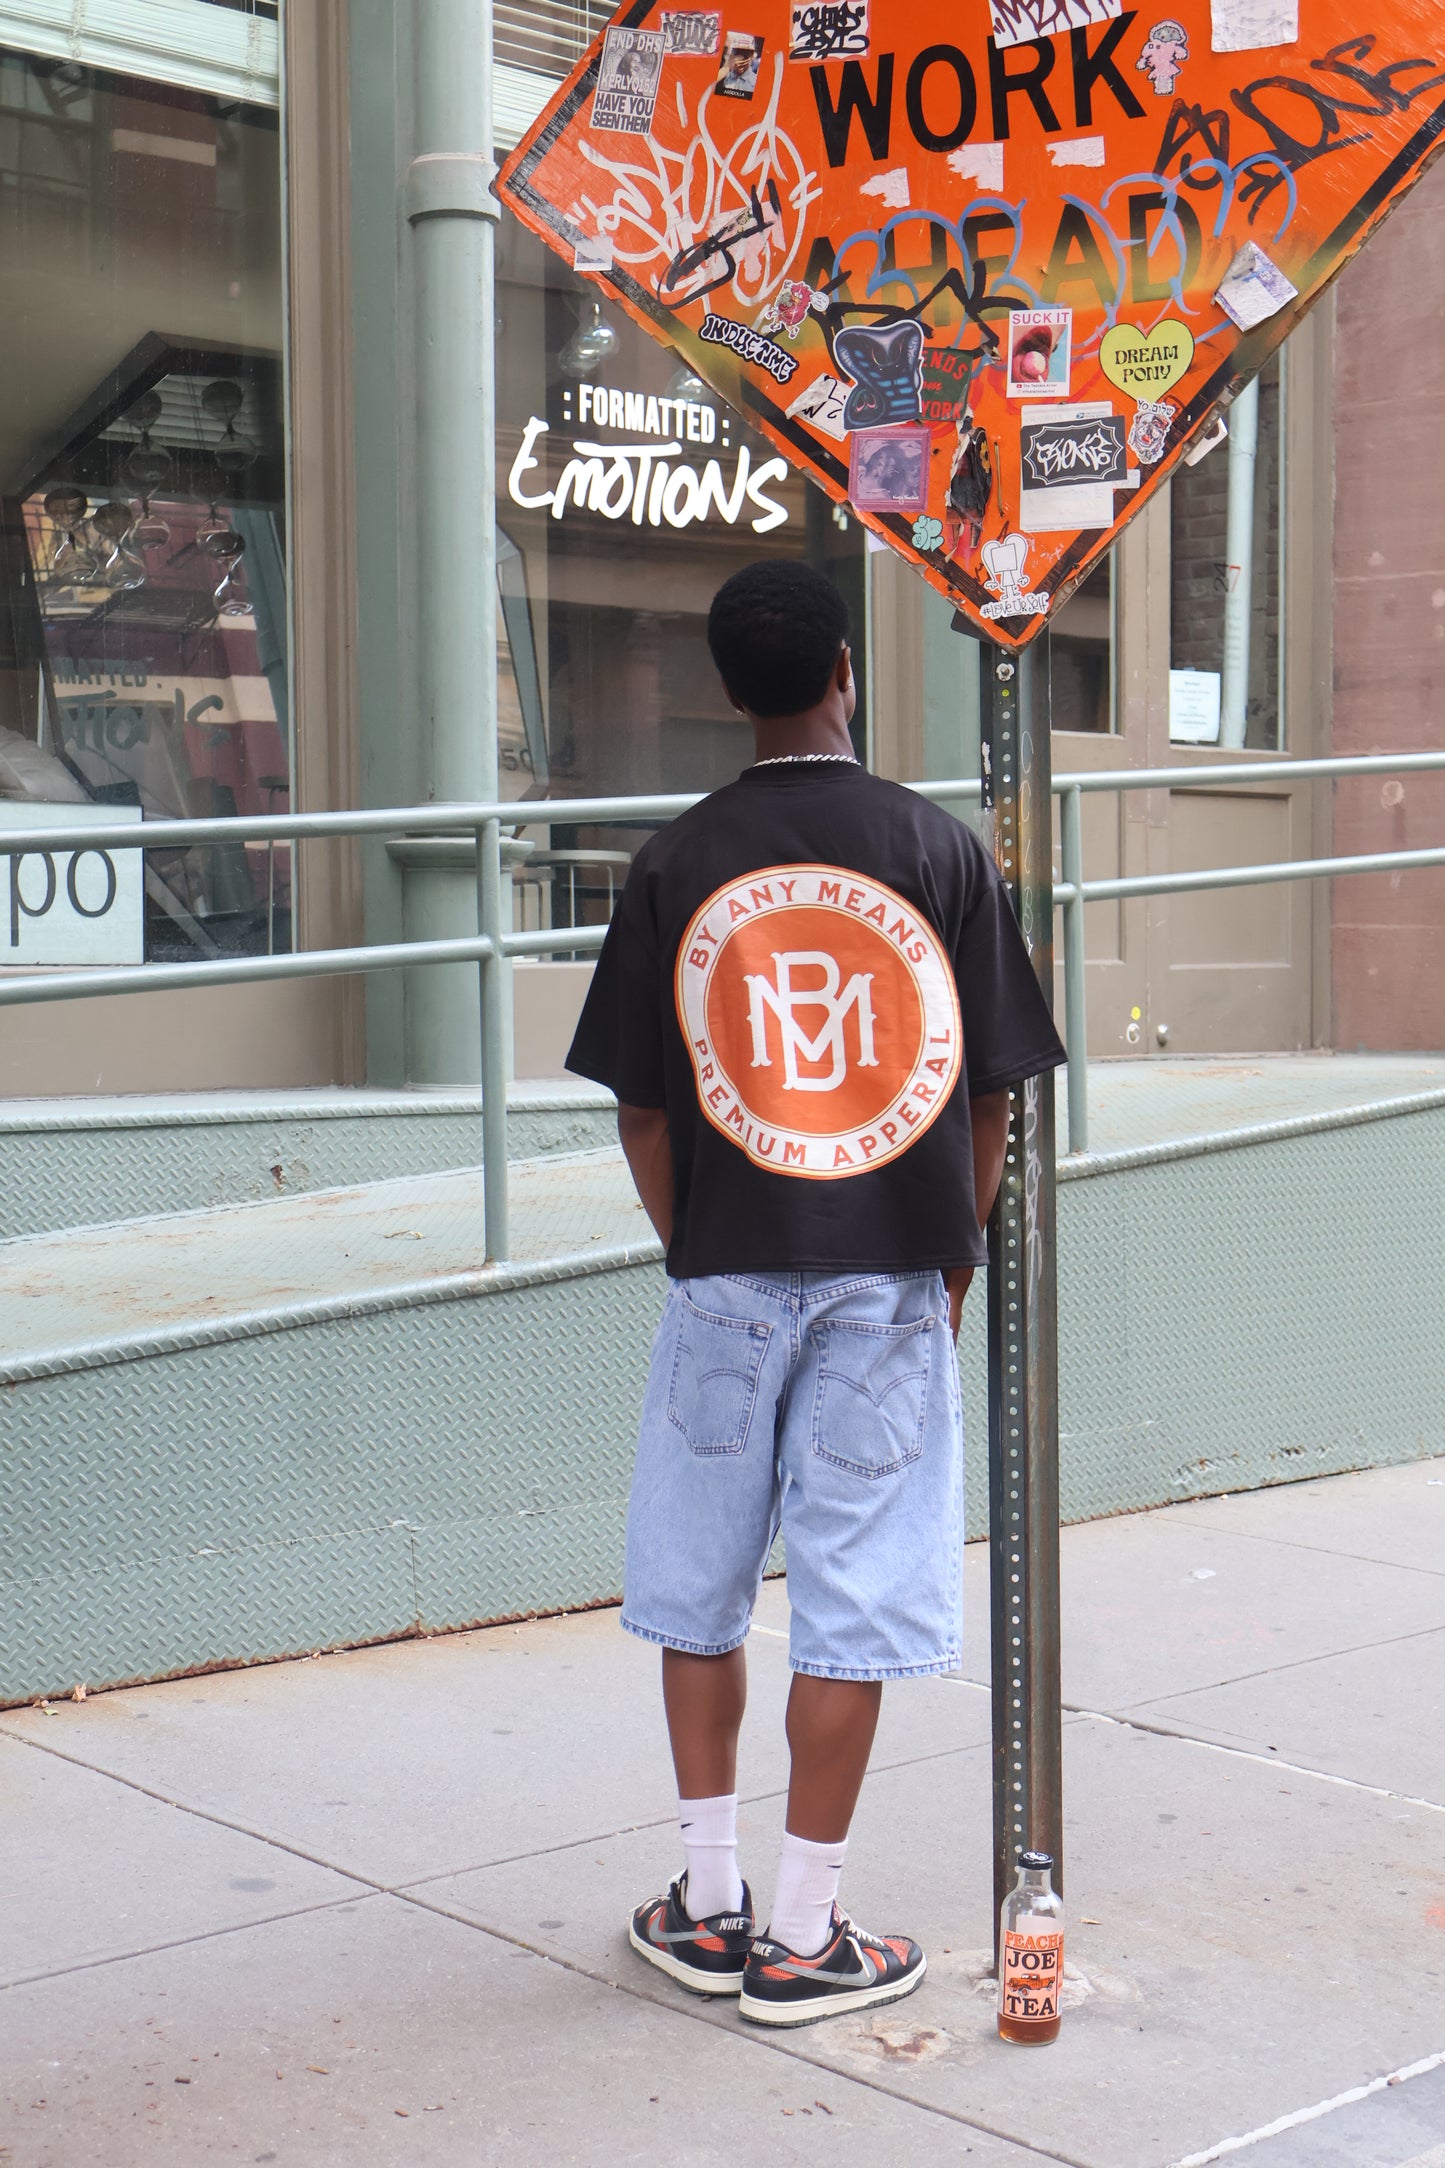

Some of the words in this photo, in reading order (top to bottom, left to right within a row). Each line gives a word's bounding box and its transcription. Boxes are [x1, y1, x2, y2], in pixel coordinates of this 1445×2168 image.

[609, 31, 634, 50] END
[637, 35, 662, 53] DHS
[810, 11, 1146, 168] WORK
[595, 93, 627, 113] HAVE
[630, 98, 654, 116] YOU
[800, 191, 1203, 328] AHEAD
[1012, 313, 1052, 325] SUCK
[1057, 312, 1070, 323] IT
[1115, 345, 1178, 365] DREAM
[1123, 365, 1171, 383] PONY
[921, 400, 963, 419] YORK
[688, 927, 719, 971] BY
[727, 880, 797, 922] ANY
[817, 880, 928, 964] MEANS
[694, 1040, 807, 1166] PREMIUM
[832, 1028, 950, 1167] APPERAL
[719, 1918, 745, 1931] NIKE
[751, 1940, 774, 1957] NIKE
[1005, 1930, 1059, 1950] PEACH
[1007, 1951, 1056, 1971] JOE
[1007, 1994, 1054, 2016] TEA
